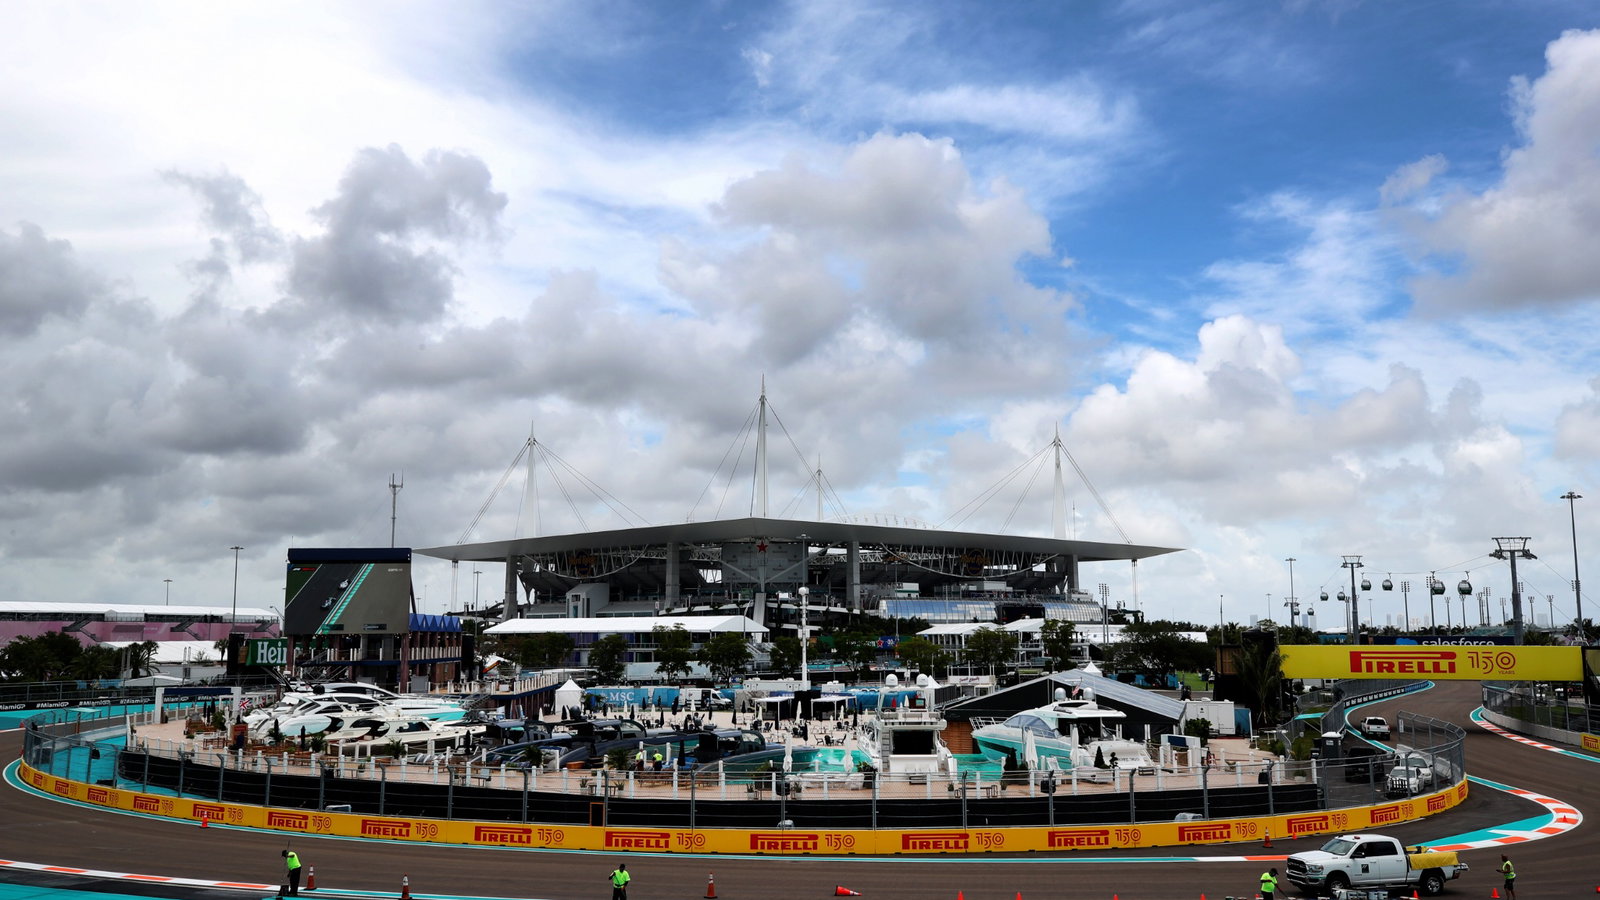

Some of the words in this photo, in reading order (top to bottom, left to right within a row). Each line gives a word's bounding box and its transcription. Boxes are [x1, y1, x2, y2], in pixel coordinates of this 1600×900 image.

[1422, 638, 1495, 646] salesforce
[1350, 651, 1456, 673] PIRELLI
[1468, 652, 1515, 674] 150
[609, 691, 635, 702] MSC
[87, 788, 108, 803] PIRELLI
[133, 796, 160, 811] PIRELLI
[1427, 795, 1446, 812] PIRELLI
[267, 811, 309, 829] PIRELLI
[312, 816, 331, 831] 150
[1287, 815, 1329, 834] PIRELLI
[1331, 814, 1348, 829] 150
[1370, 806, 1399, 824] PIRELLI
[361, 819, 411, 837] PIRELLI
[415, 823, 438, 839] 150
[474, 826, 532, 844] PIRELLI
[537, 829, 564, 845] 150
[1048, 830, 1110, 847] PIRELLI
[1115, 829, 1141, 846] 150
[1178, 824, 1231, 842] PIRELLI
[1235, 822, 1257, 838] 150
[605, 831, 671, 848] PIRELLI
[676, 831, 705, 850] 150
[750, 834, 819, 851] PIRELLI
[825, 834, 855, 851] 150
[902, 833, 969, 850] PIRELLI
[976, 832, 1004, 849] 150
